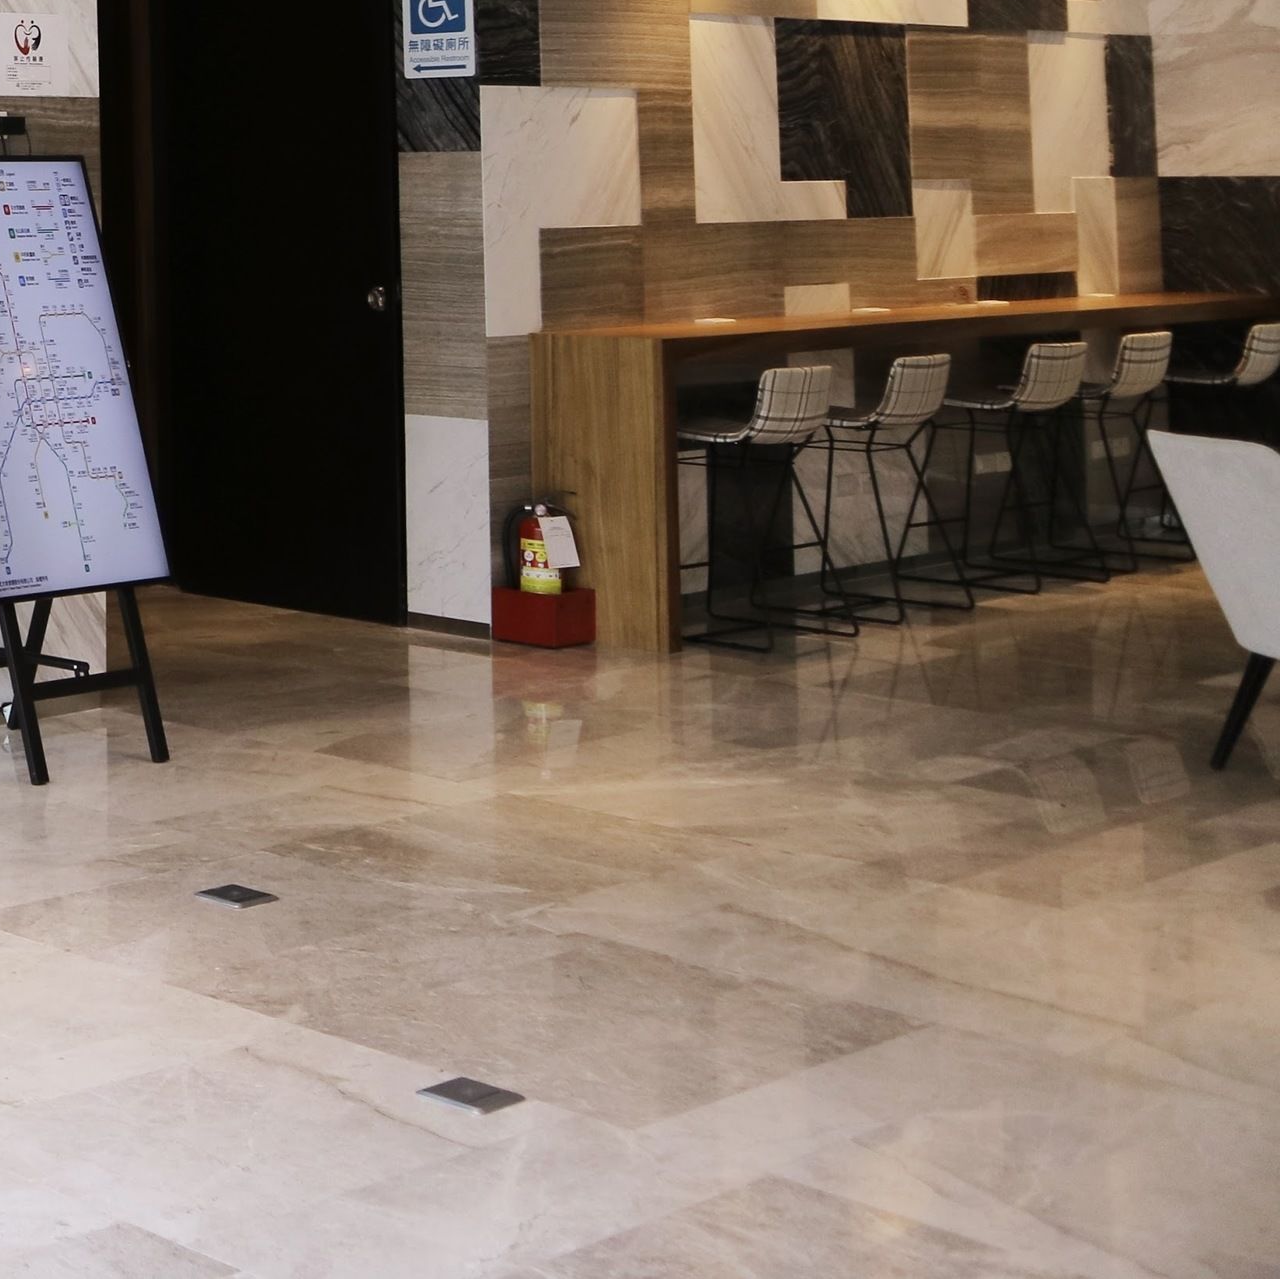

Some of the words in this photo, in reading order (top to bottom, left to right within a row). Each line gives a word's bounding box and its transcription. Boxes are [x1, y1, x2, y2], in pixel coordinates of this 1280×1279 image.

[408, 37, 469, 52] 無障礙廁所
